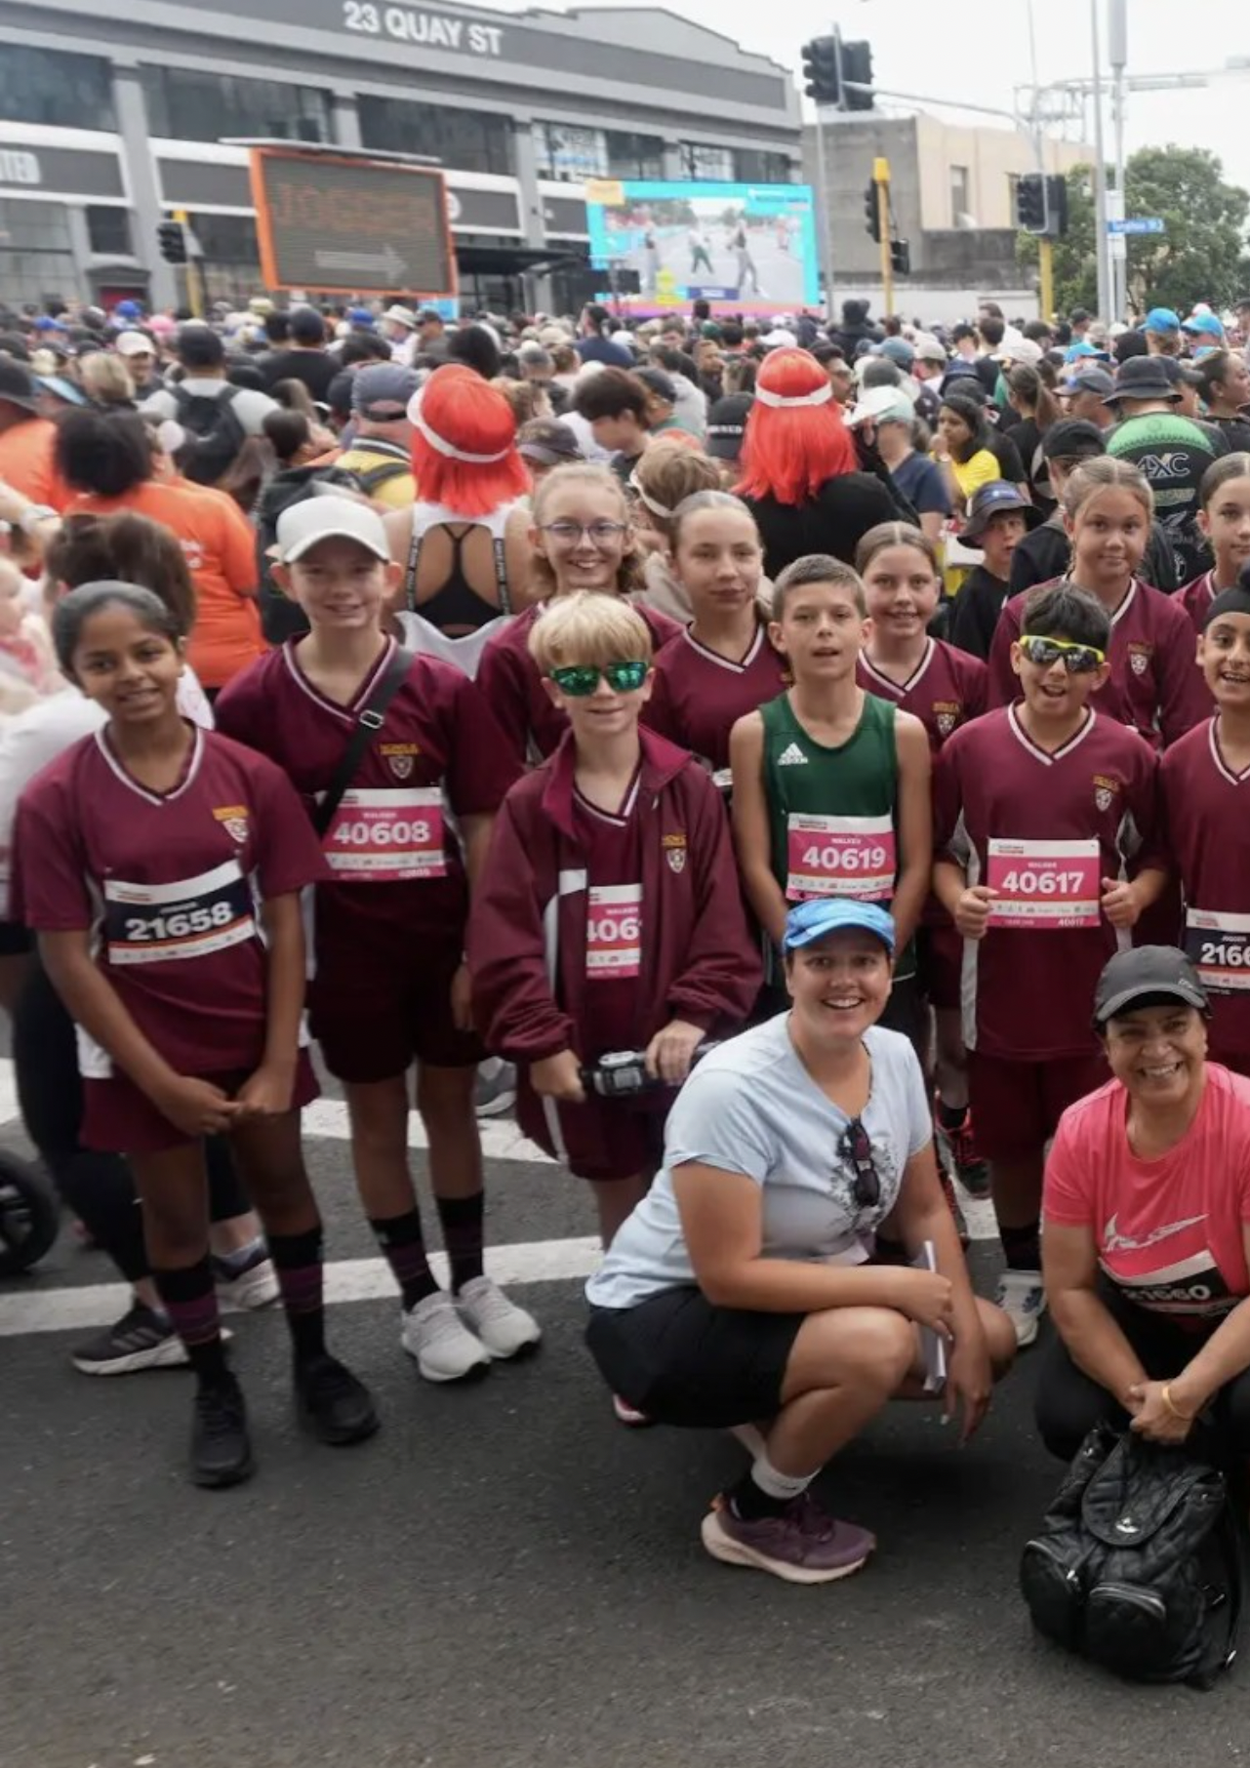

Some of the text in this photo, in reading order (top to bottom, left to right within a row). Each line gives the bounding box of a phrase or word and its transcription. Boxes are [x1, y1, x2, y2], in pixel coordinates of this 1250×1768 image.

[343, 1, 503, 55] 23 QUAY ST
[333, 820, 431, 845] 40608
[802, 846, 886, 870] 40619
[1002, 871, 1084, 894] 40617
[125, 901, 233, 940] 21658
